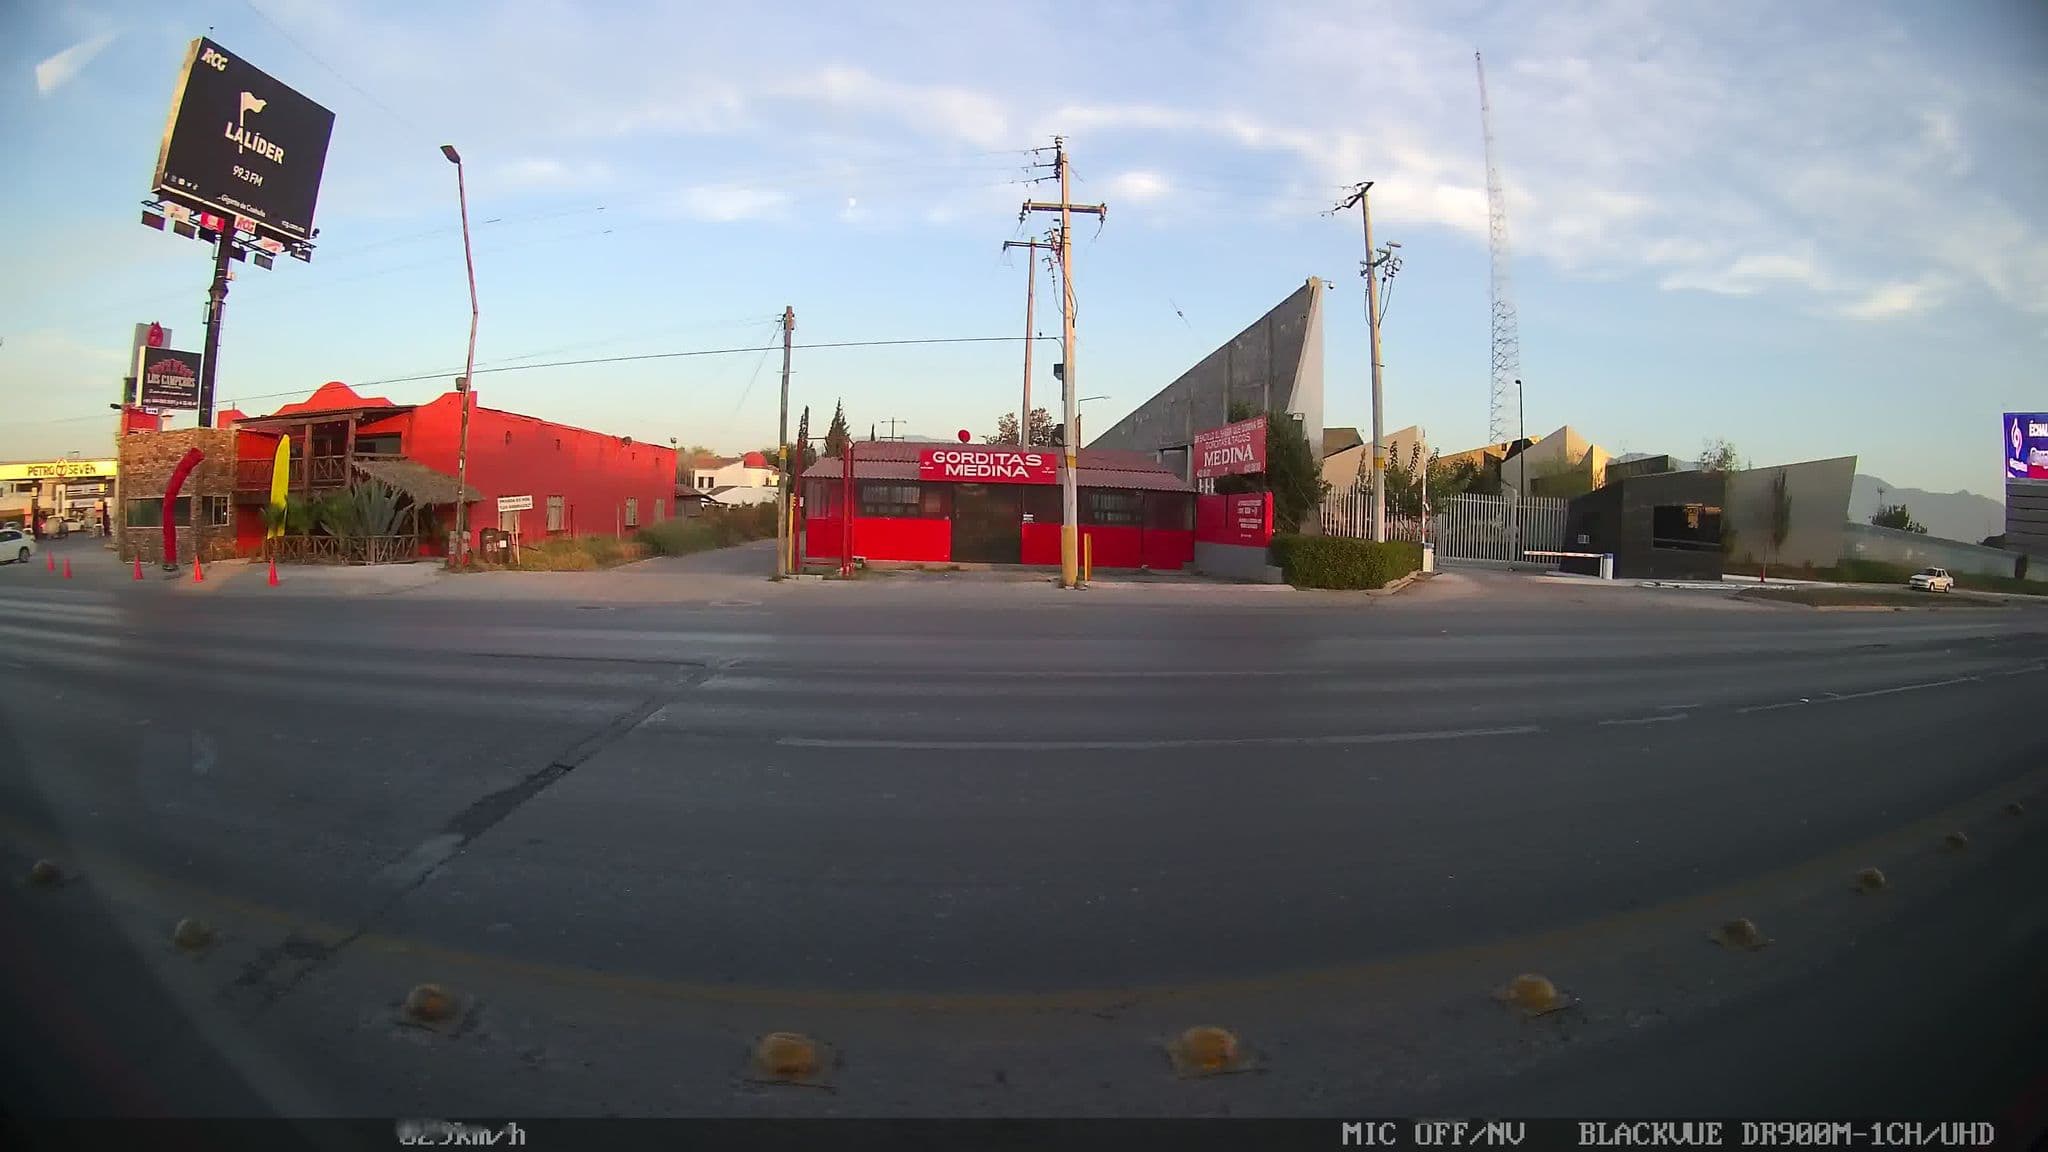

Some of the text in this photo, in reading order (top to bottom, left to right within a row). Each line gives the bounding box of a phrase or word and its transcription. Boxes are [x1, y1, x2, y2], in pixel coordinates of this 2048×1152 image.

[201, 47, 228, 71] RCG
[233, 165, 264, 187] 99.3 FM
[932, 451, 1042, 467] GORDITAS
[1204, 444, 1254, 467] MEDINA
[28, 465, 54, 477] PETRO
[68, 463, 96, 475] SEVEN
[945, 463, 1030, 478] MEDINA
